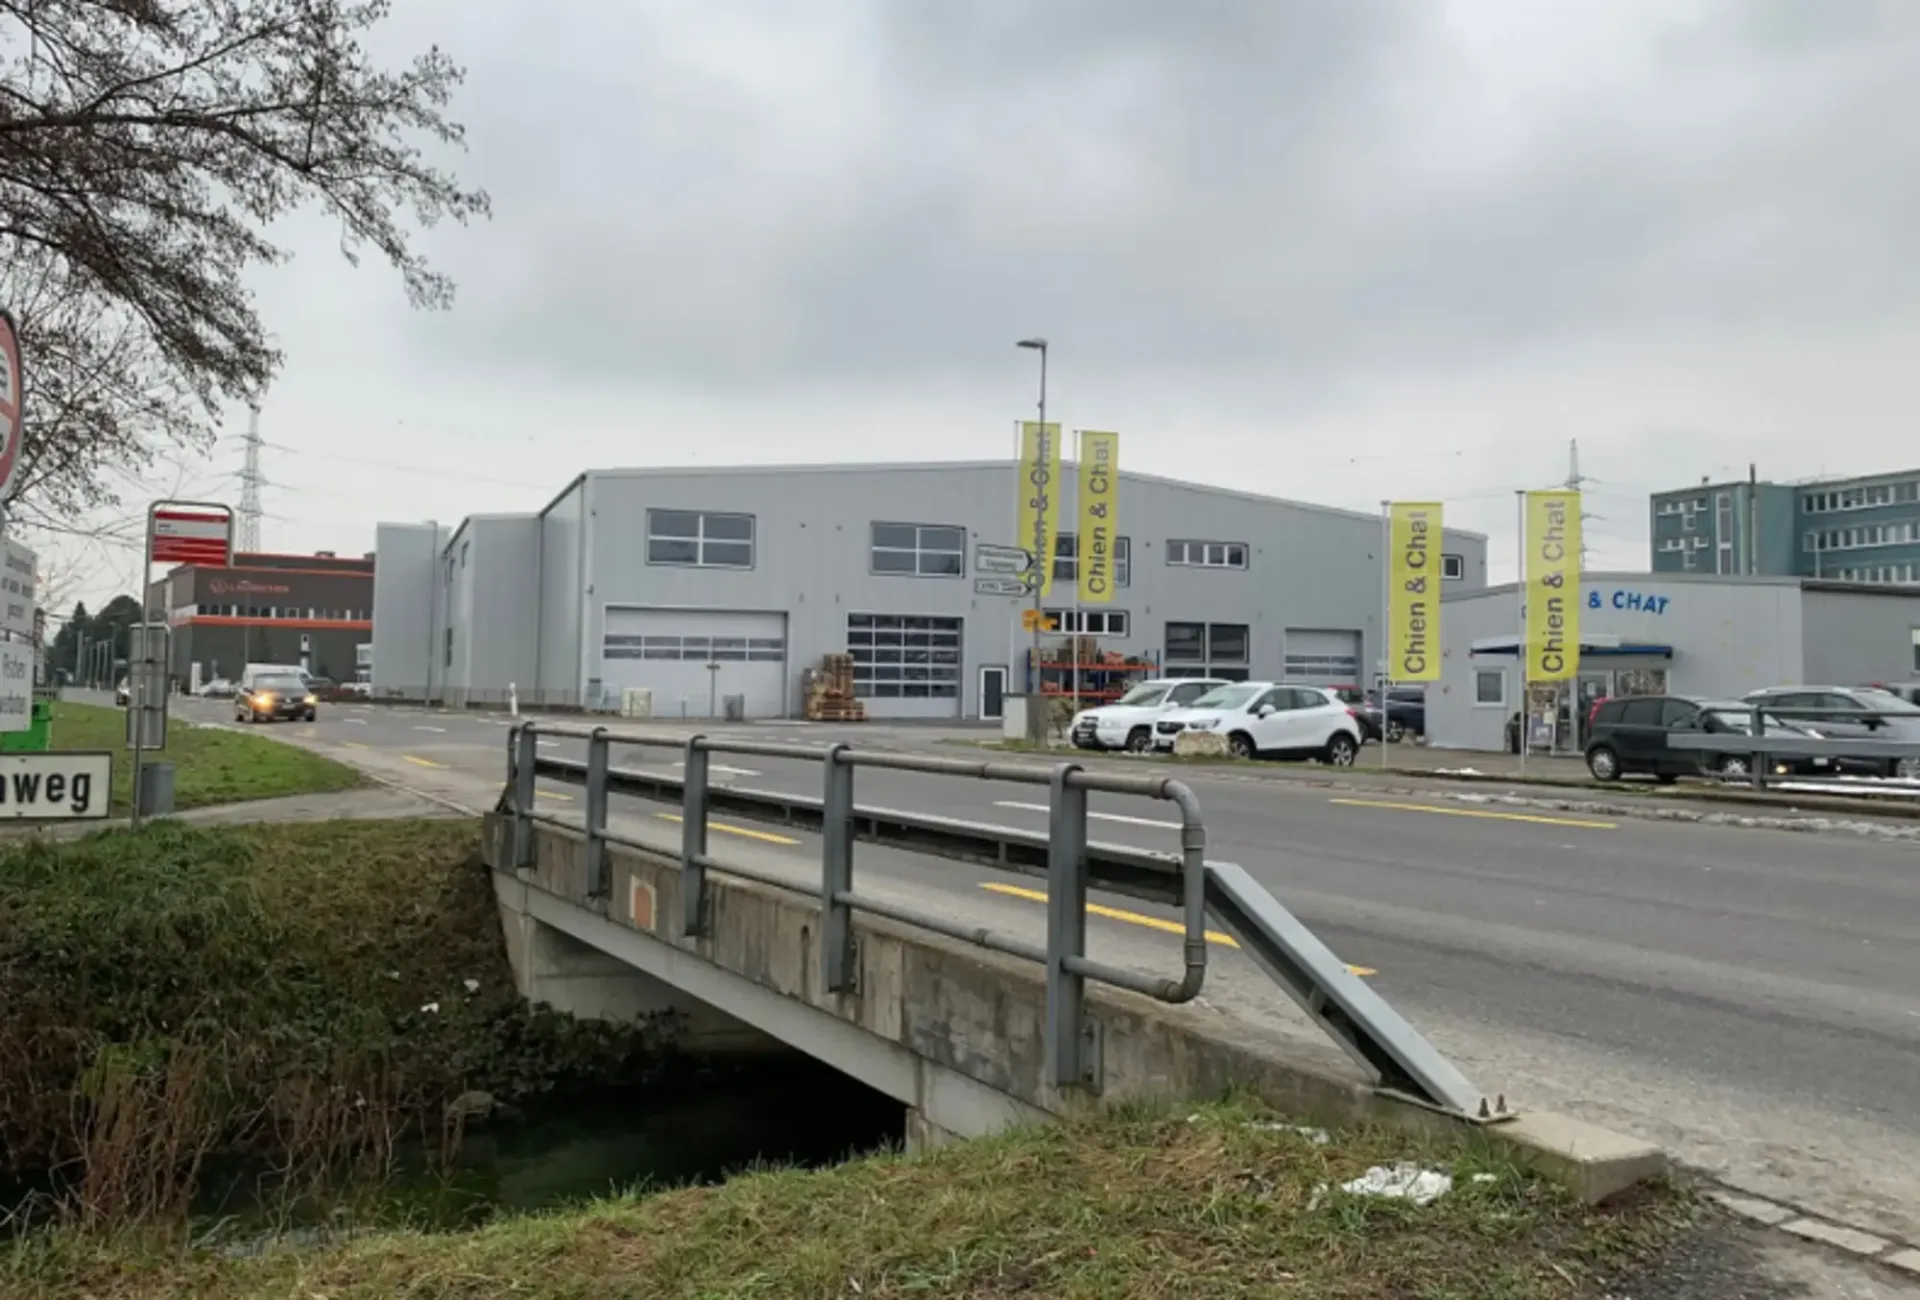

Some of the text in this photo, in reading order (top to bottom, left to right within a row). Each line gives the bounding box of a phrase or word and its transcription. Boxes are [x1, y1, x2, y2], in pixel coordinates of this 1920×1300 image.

[1088, 440, 1109, 594] Chien & Chat
[1404, 511, 1428, 674] Chien & Chat
[1542, 501, 1565, 673] Chien & Chat
[1588, 591, 1671, 615] & CHAT
